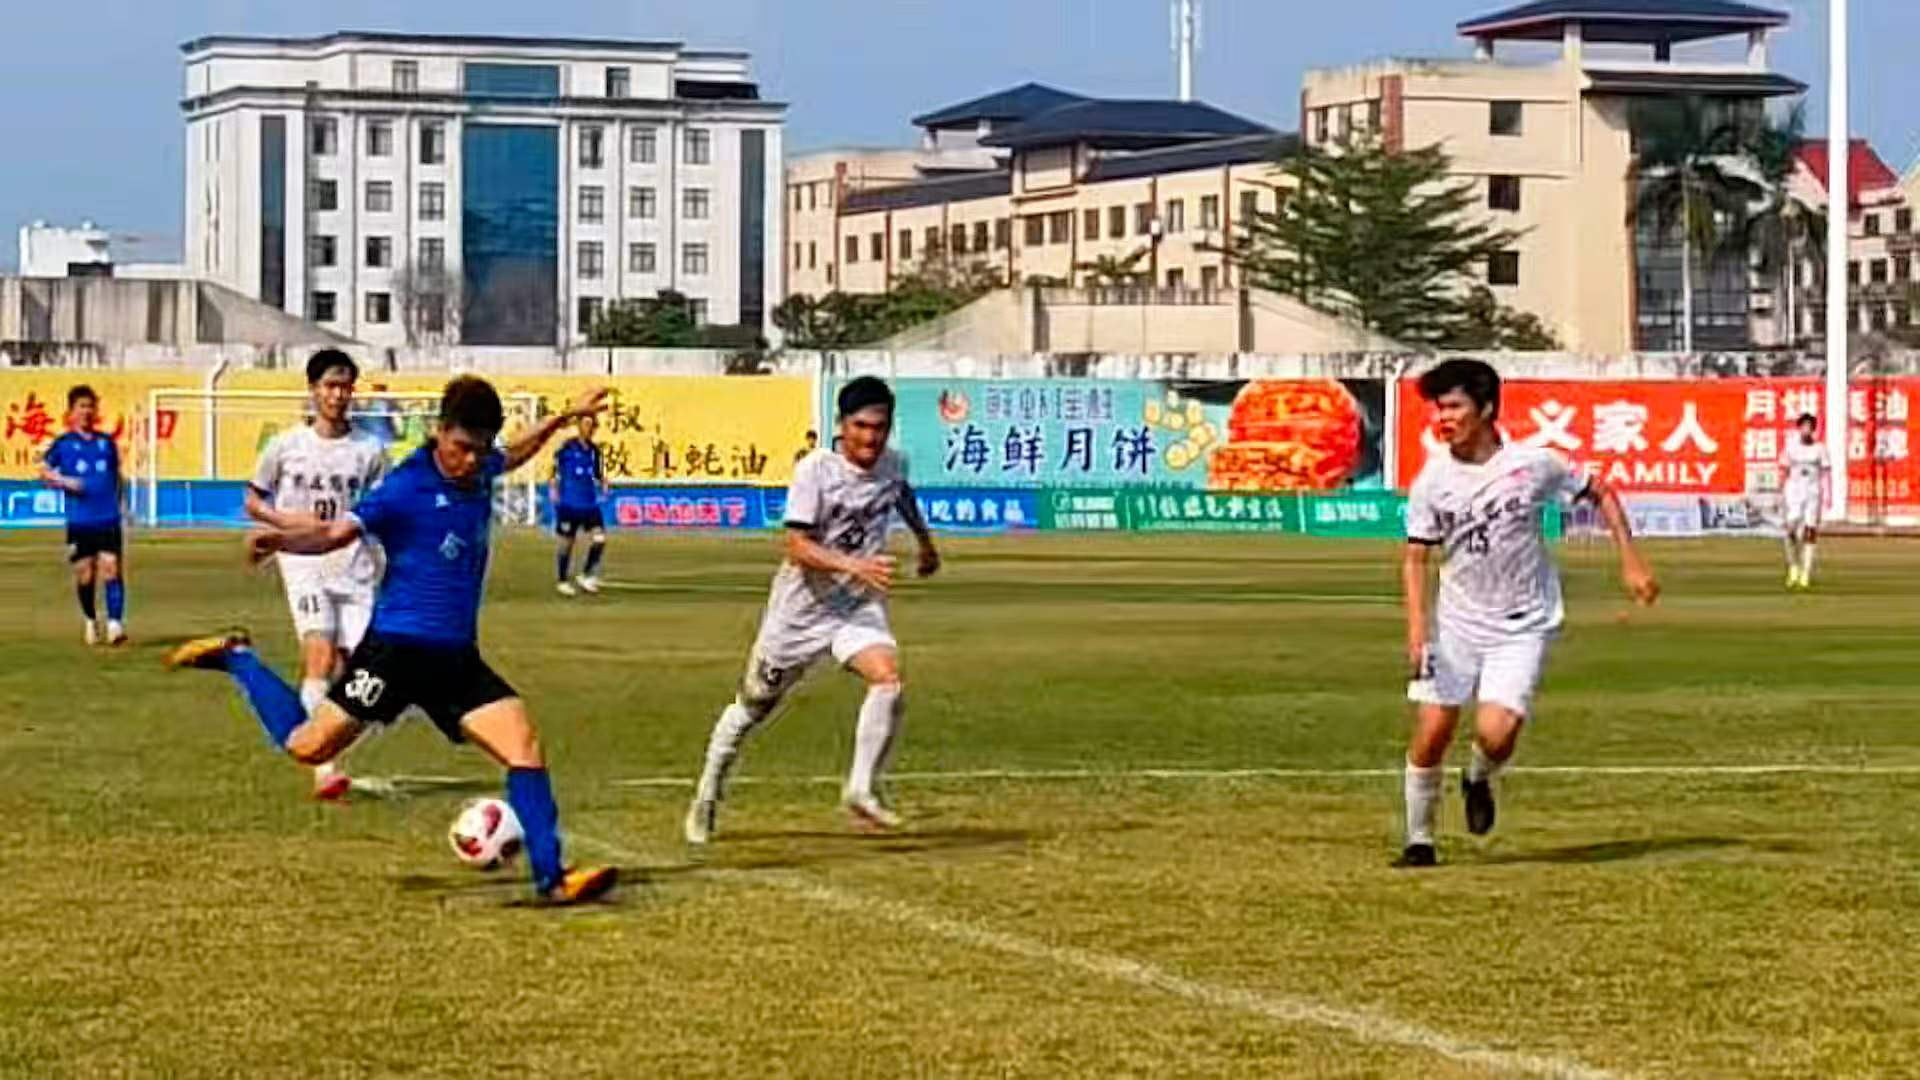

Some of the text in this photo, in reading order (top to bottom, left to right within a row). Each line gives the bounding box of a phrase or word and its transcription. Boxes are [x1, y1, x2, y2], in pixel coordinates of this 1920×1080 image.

[1501, 399, 1719, 453] 义家人
[946, 424, 1156, 475] 海鲜月饼
[1583, 460, 1718, 486] FAMILY
[916, 497, 1026, 523] 吃的食品
[345, 668, 387, 707] 30
